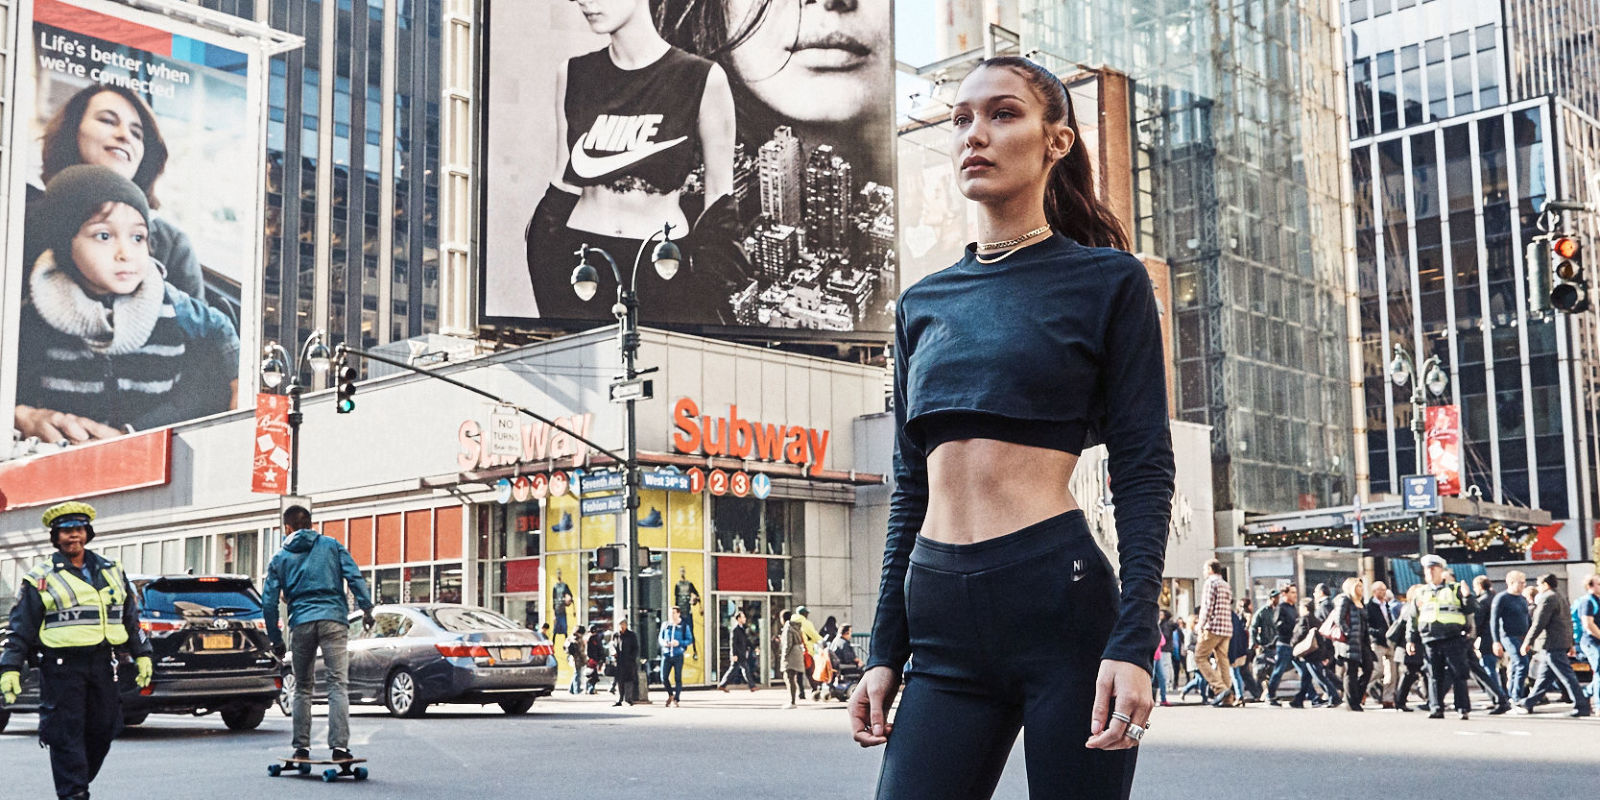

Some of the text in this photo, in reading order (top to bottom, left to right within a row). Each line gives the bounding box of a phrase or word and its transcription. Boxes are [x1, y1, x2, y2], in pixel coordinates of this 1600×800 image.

[40, 31, 190, 85] Life's better when
[39, 54, 176, 98] we're connected
[583, 114, 664, 152] NIKE
[498, 419, 514, 429] NO
[672, 397, 830, 476] Subway
[582, 475, 608, 490] Seventh
[608, 472, 622, 486] Ave
[644, 473, 664, 487] West
[680, 477, 689, 490] St
[690, 471, 747, 494] 1 2 3
[583, 498, 621, 513] Fashion Ave
[58, 610, 82, 621] NY
